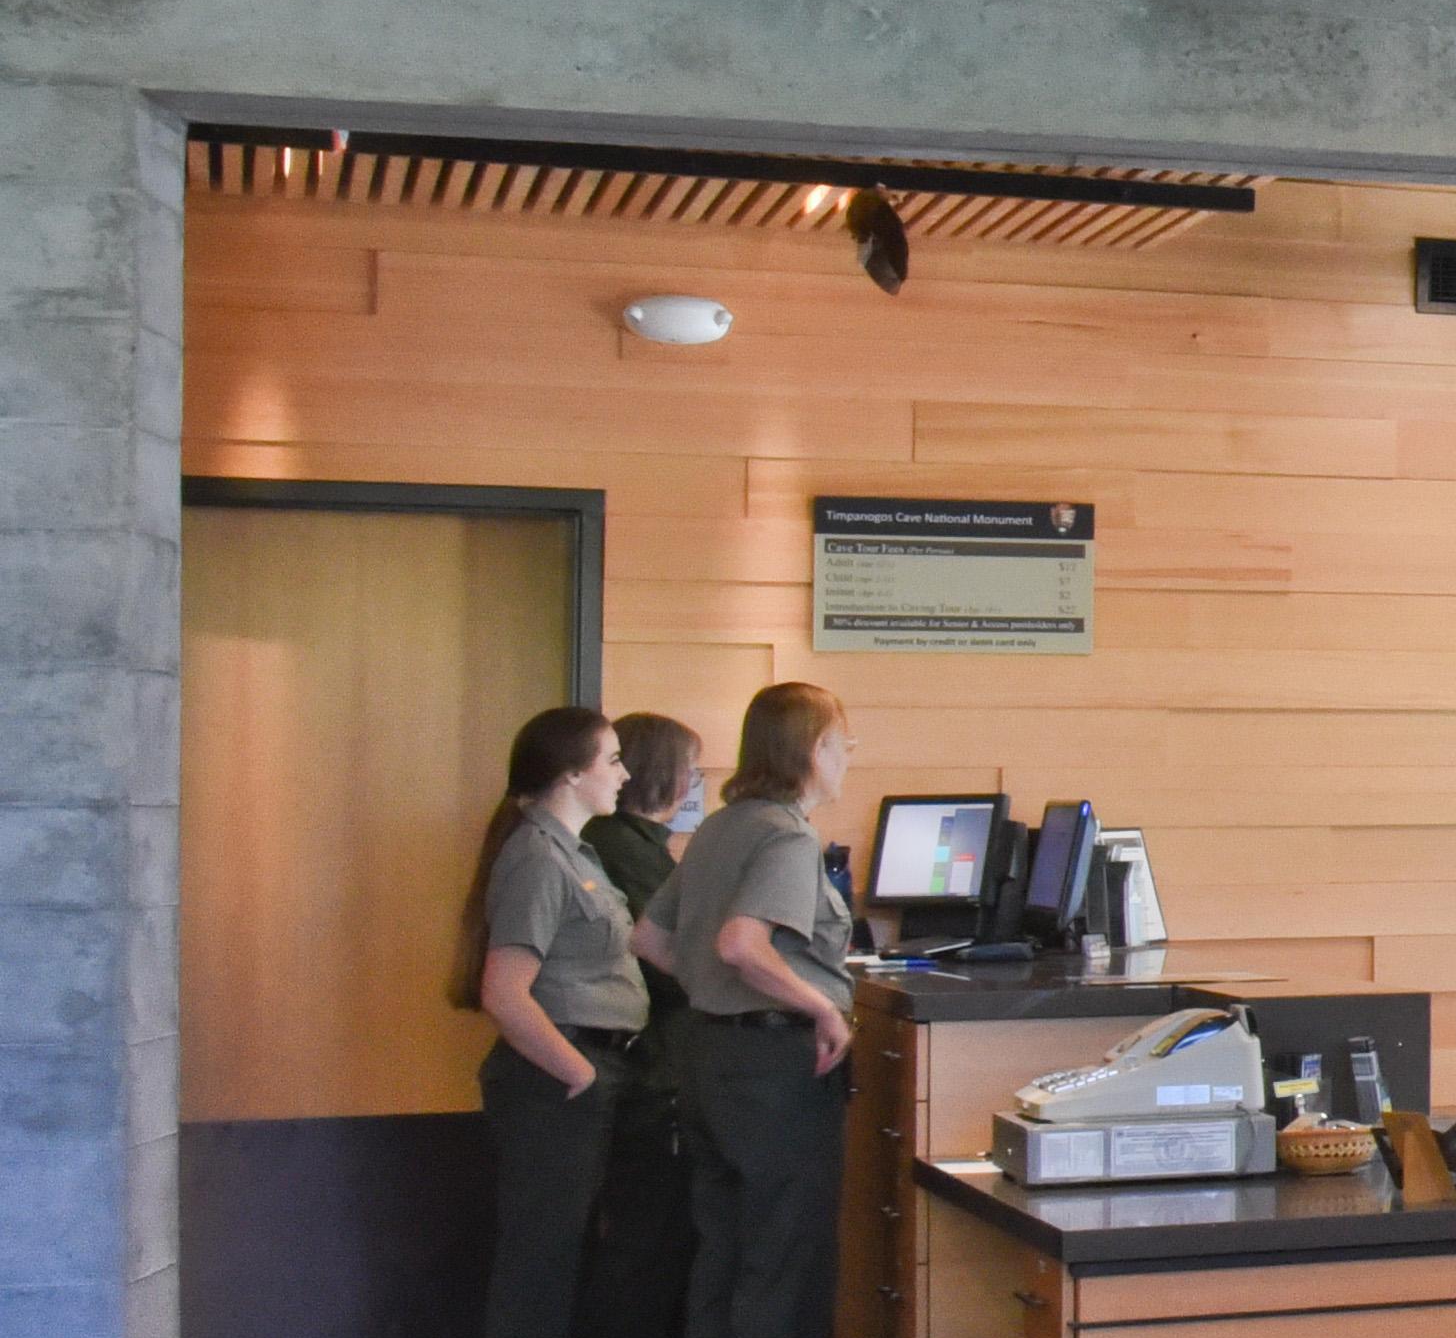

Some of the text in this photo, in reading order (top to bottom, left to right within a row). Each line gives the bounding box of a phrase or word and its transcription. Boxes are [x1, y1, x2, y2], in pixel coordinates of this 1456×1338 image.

[826, 510, 1033, 526] Timpanogos Cave National Monument
[828, 541, 853, 552] Cave
[857, 543, 880, 553] Tour
